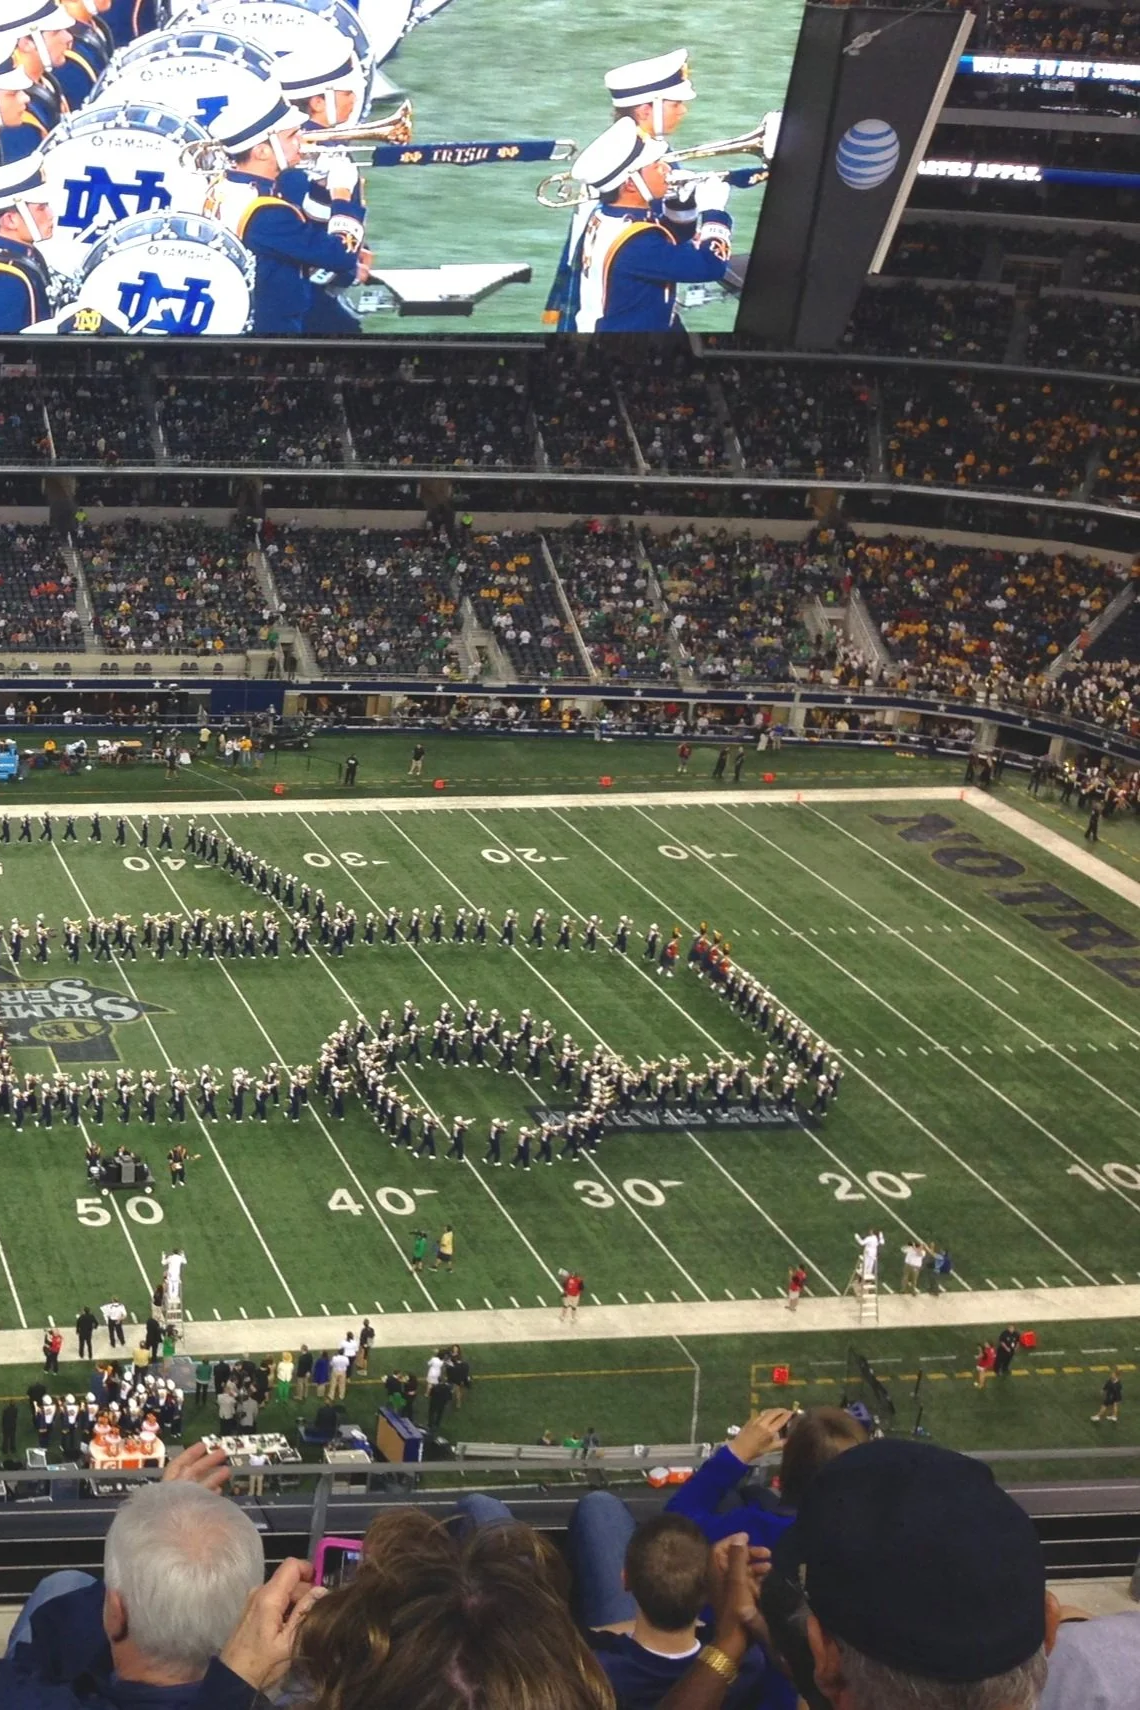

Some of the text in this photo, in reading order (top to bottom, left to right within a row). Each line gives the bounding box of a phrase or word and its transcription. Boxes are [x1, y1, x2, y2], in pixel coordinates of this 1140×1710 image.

[432, 147, 490, 163] IRISH
[818, 1170, 912, 1201] 20
[1067, 1161, 1140, 1191] 10
[327, 1186, 417, 1217] 40
[573, 1177, 666, 1209] 30
[76, 1196, 164, 1227] 50
